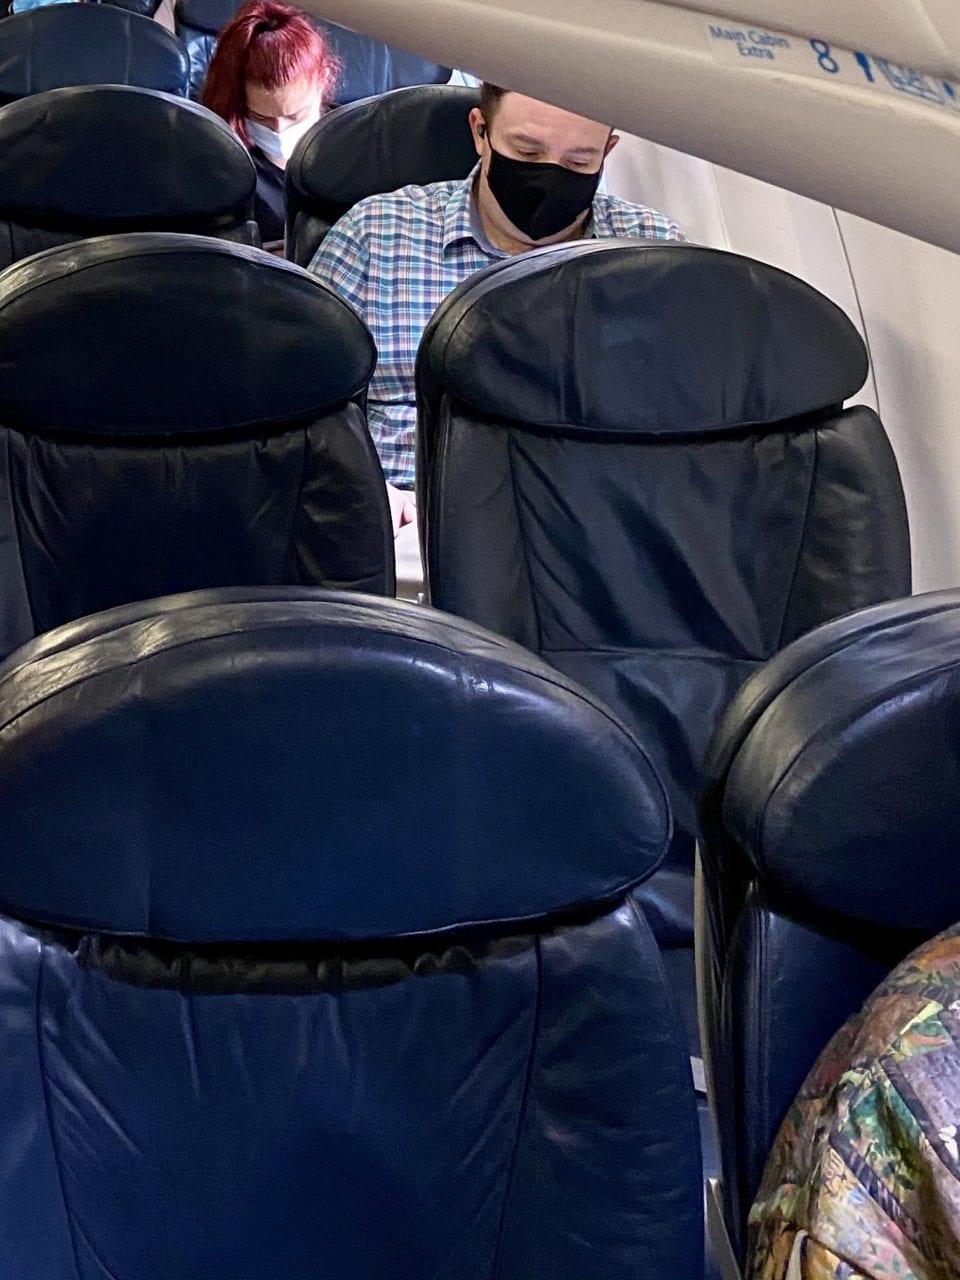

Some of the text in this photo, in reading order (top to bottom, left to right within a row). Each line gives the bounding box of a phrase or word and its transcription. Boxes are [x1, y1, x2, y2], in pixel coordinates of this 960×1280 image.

[709, 25, 790, 49] Main Cabin
[736, 41, 774, 59] Extra
